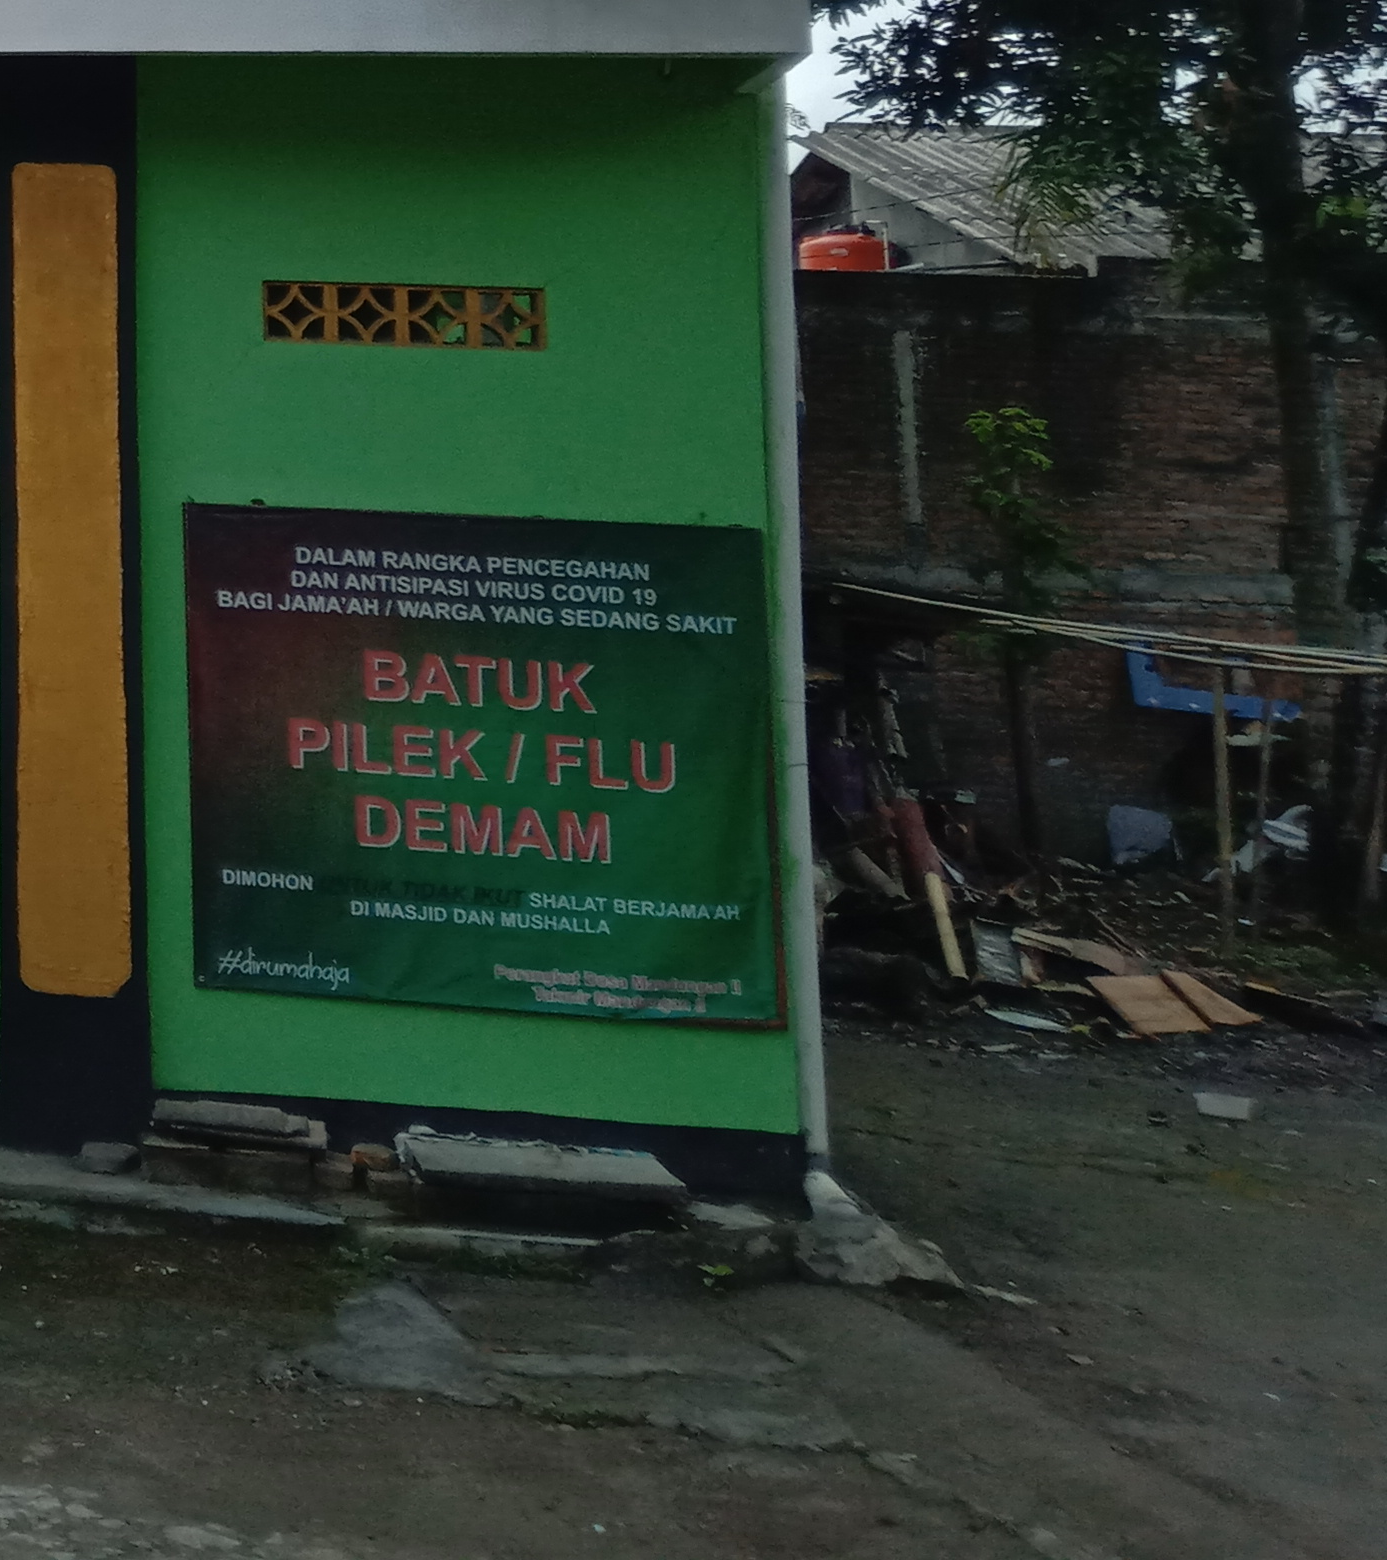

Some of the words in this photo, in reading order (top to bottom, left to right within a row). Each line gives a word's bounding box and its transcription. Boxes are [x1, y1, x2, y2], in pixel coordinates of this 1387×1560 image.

[295, 546, 376, 567] DALAM
[382, 551, 482, 573] RANGKA
[487, 557, 650, 582] PENCEGAHAN
[290, 570, 339, 589] DAN
[344, 573, 469, 597] ANTISIPASI
[475, 581, 545, 601] VIRUS
[551, 584, 625, 604] COVID
[632, 588, 657, 607] 19
[217, 590, 273, 610] BAGI
[397, 599, 486, 622] WARGA
[490, 606, 554, 626] YANG
[560, 608, 660, 631] SEDANG
[666, 614, 737, 635] SAKIT
[363, 648, 597, 714] BATUK
[287, 717, 488, 782] PILEK
[505, 732, 525, 784] /
[545, 734, 676, 794] FLU
[354, 795, 611, 864] DEMAM
[222, 868, 314, 891] DIMOHON
[529, 892, 608, 912] SHALAT
[350, 900, 369, 916] DI
[375, 902, 447, 922] MASJID
[453, 908, 495, 926] DAN
[501, 911, 610, 935] MUSHALLA
[218, 946, 349, 991] #dirumahaja
